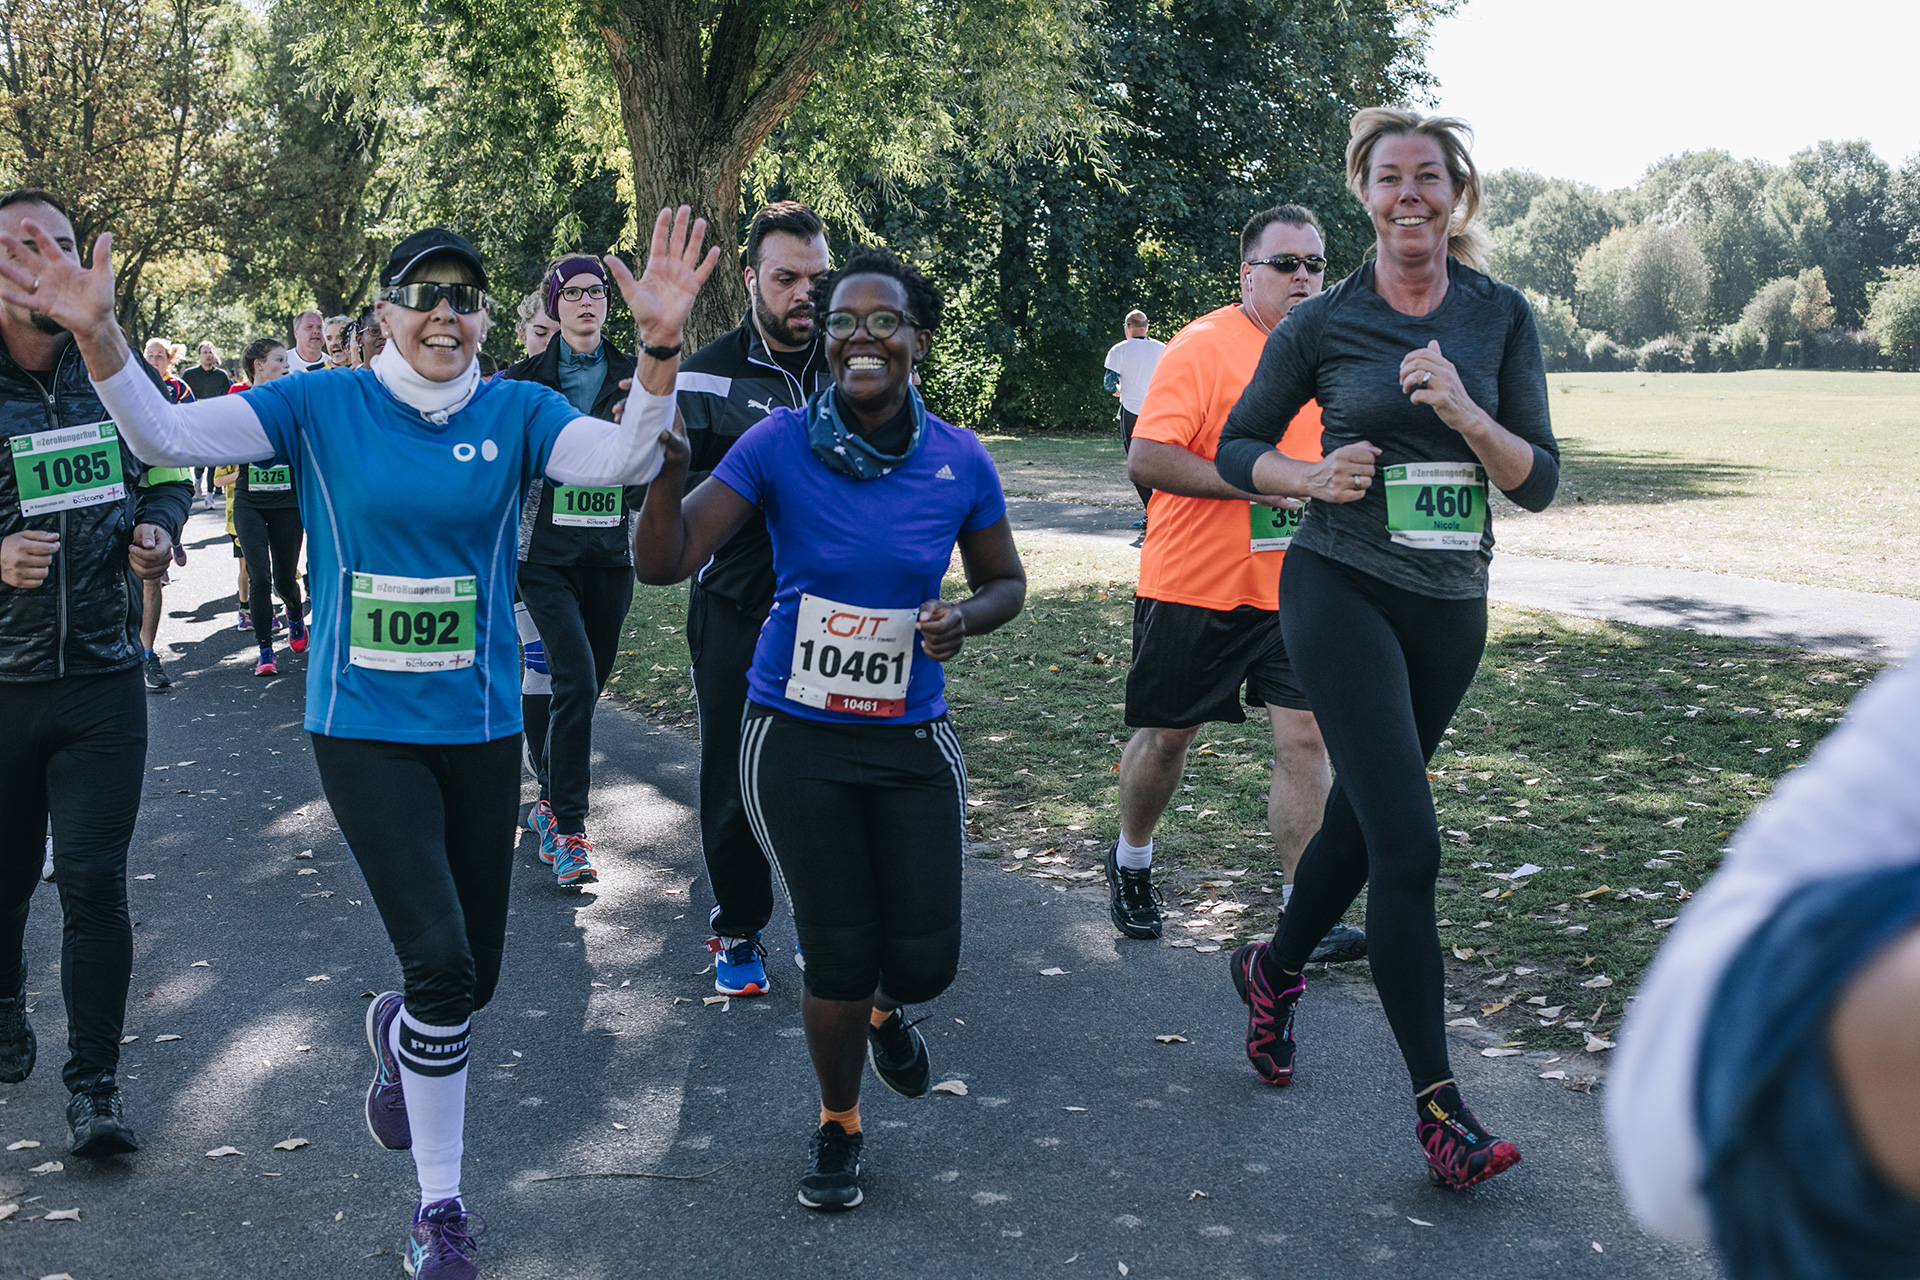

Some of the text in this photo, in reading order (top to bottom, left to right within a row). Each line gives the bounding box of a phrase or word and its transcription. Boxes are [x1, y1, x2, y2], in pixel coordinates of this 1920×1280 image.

[36, 430, 97, 447] #ZeroHungerRun
[32, 451, 110, 491] 1085
[254, 470, 285, 482] 1375
[1411, 468, 1474, 479] #ZeroHungerRun
[564, 490, 616, 512] 1086
[1415, 486, 1472, 518] 460
[1271, 506, 1306, 528] 39
[1433, 520, 1460, 530] Nicole
[376, 583, 451, 595] #ZeroHungerRun
[367, 608, 460, 646] 1092
[827, 612, 889, 638] GIT
[800, 639, 905, 685] 10461
[842, 698, 878, 712] 10461
